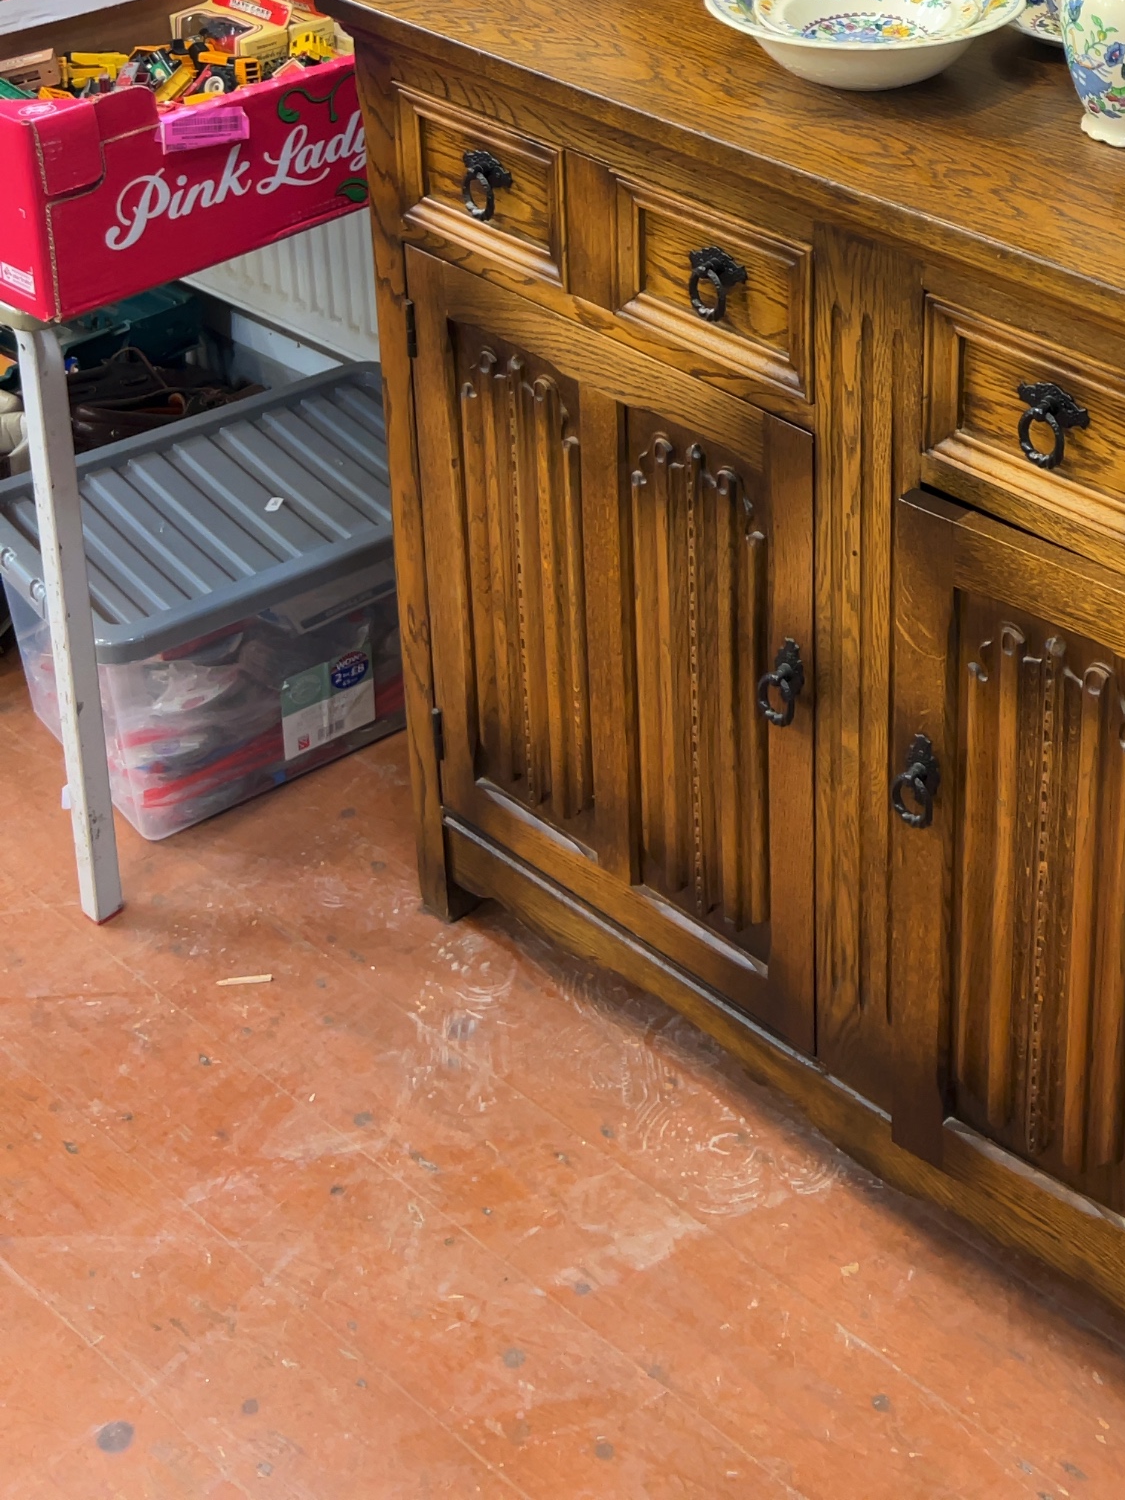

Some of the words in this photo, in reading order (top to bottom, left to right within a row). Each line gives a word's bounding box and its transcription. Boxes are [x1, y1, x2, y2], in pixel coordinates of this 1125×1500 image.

[105, 143, 252, 250] Pink
[256, 109, 367, 195] Lady
[335, 673, 342, 684] 2
